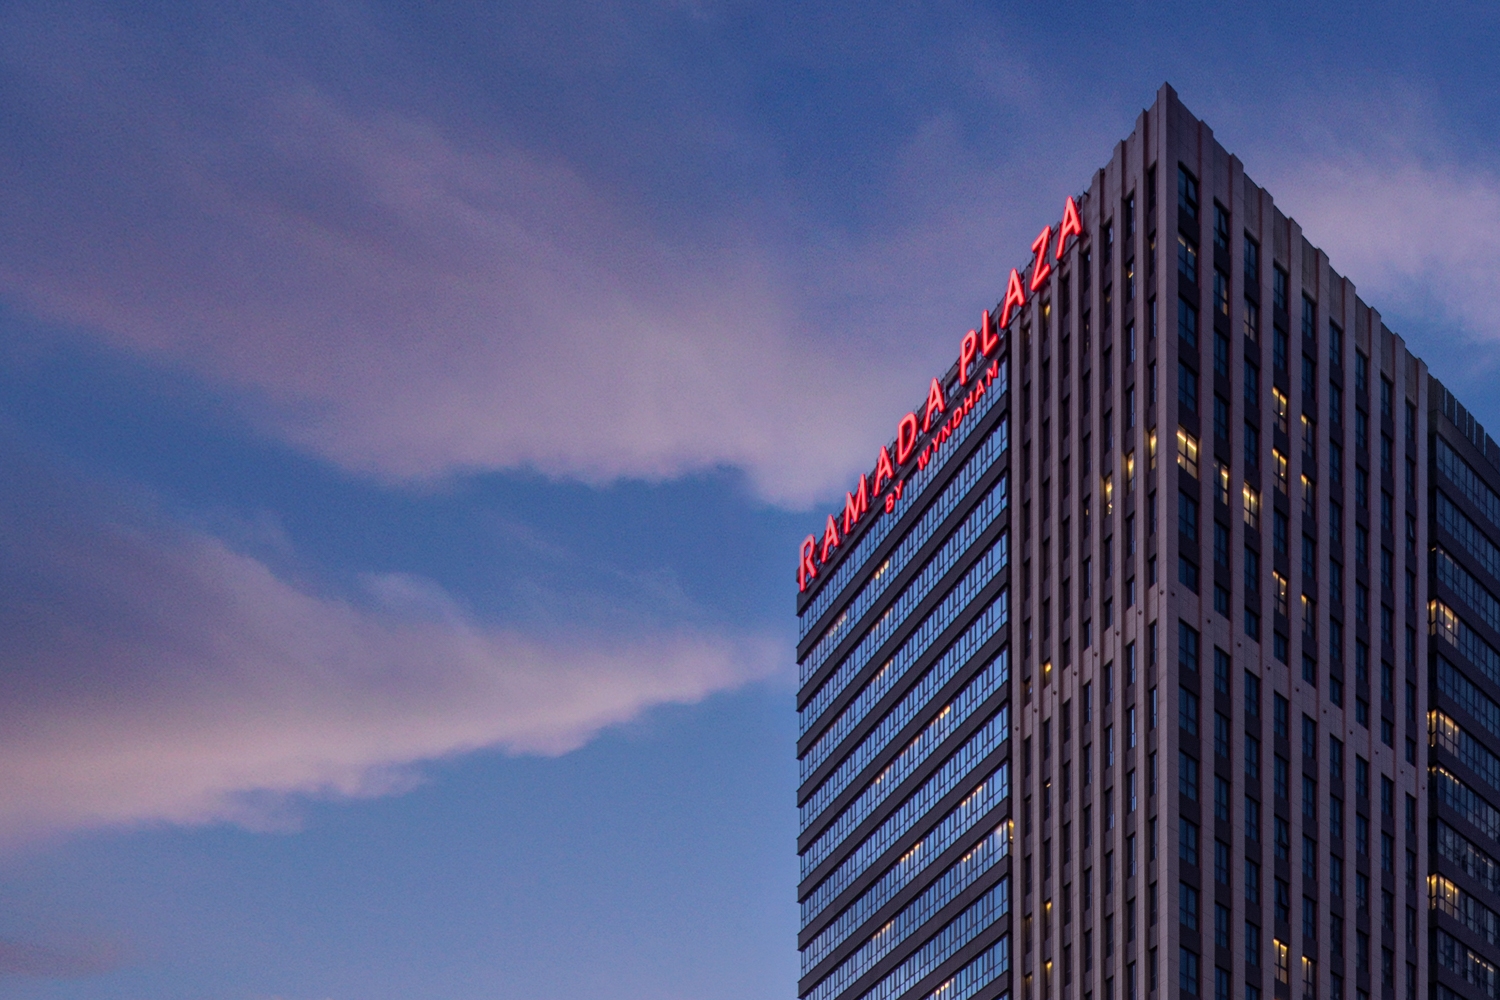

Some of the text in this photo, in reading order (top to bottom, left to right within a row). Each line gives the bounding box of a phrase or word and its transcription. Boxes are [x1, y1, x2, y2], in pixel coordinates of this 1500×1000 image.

[800, 196, 1082, 592] RAMADA PLAZA
[884, 359, 999, 514] BY WYNDHAM
